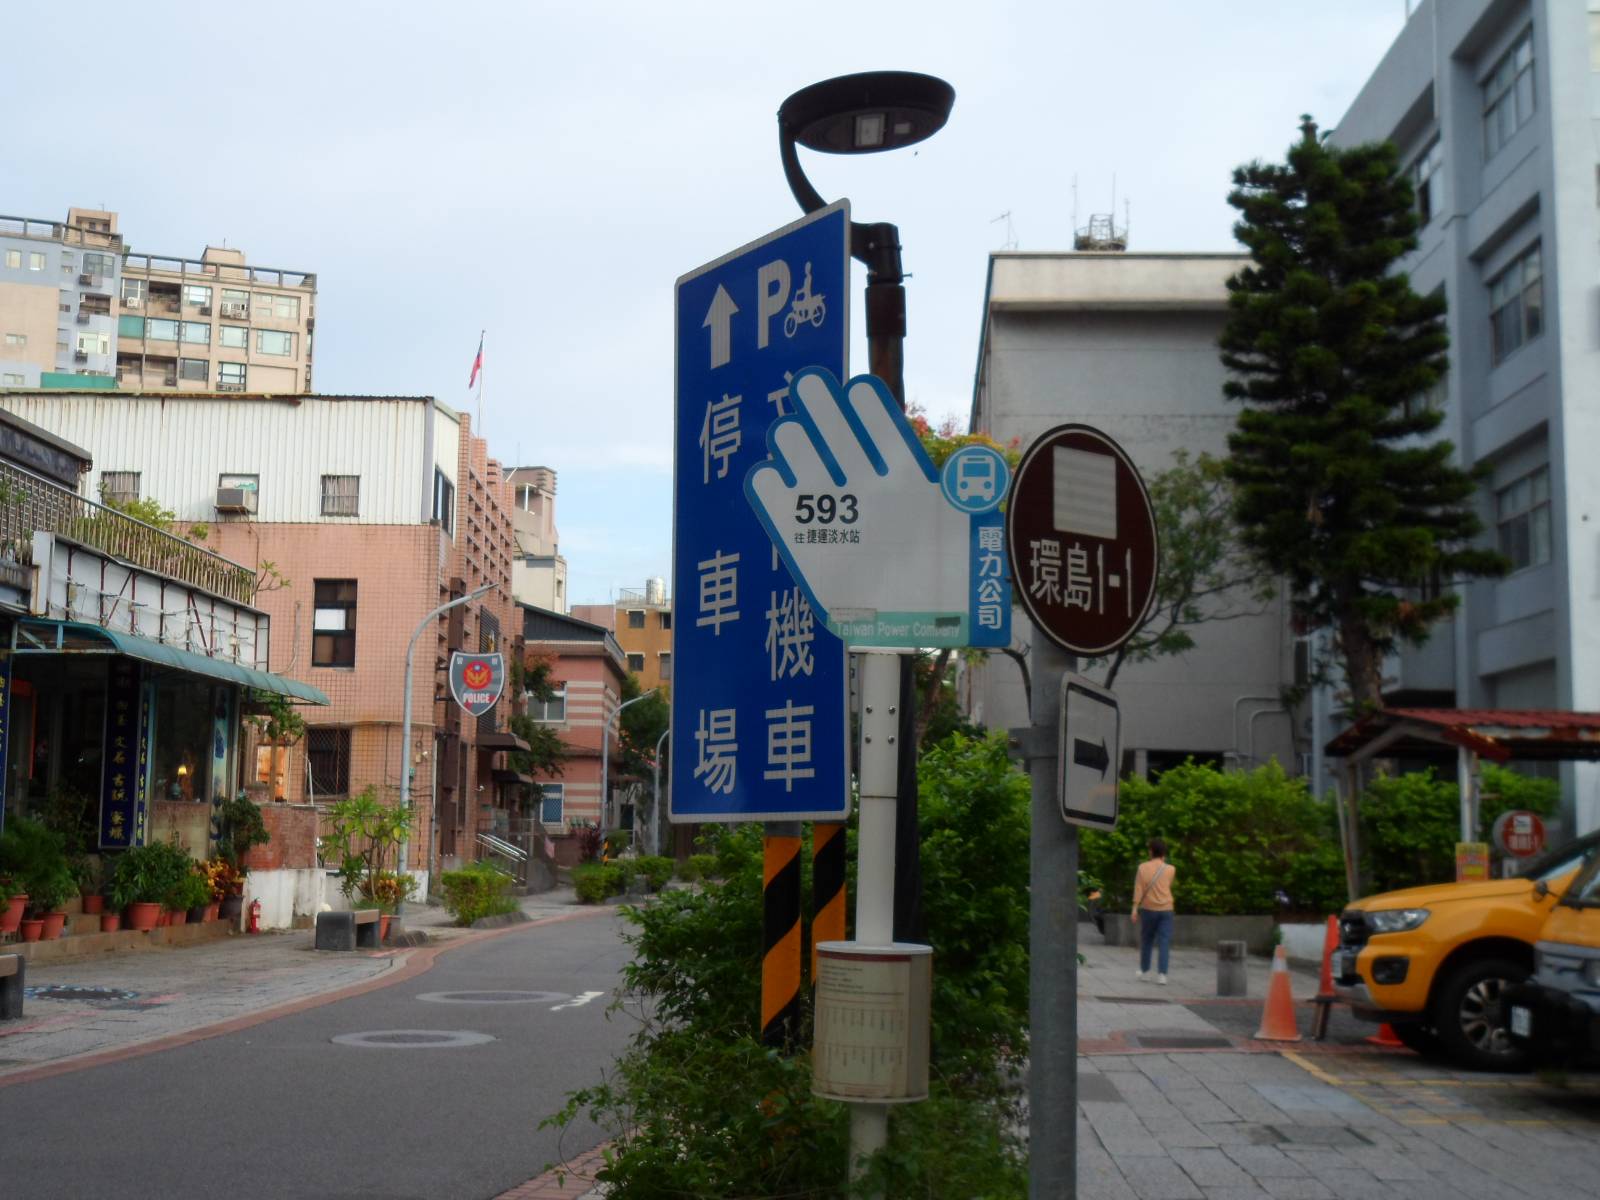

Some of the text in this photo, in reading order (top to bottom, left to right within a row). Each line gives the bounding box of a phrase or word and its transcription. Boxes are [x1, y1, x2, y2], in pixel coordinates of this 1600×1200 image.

[758, 259, 791, 350] P
[795, 494, 859, 524] 593
[692, 393, 742, 795] 停車場
[978, 526, 1003, 629] 電力公司
[1029, 539, 1132, 618] 環島1-1
[836, 622, 874, 637] Taiwan
[878, 622, 909, 637] Power
